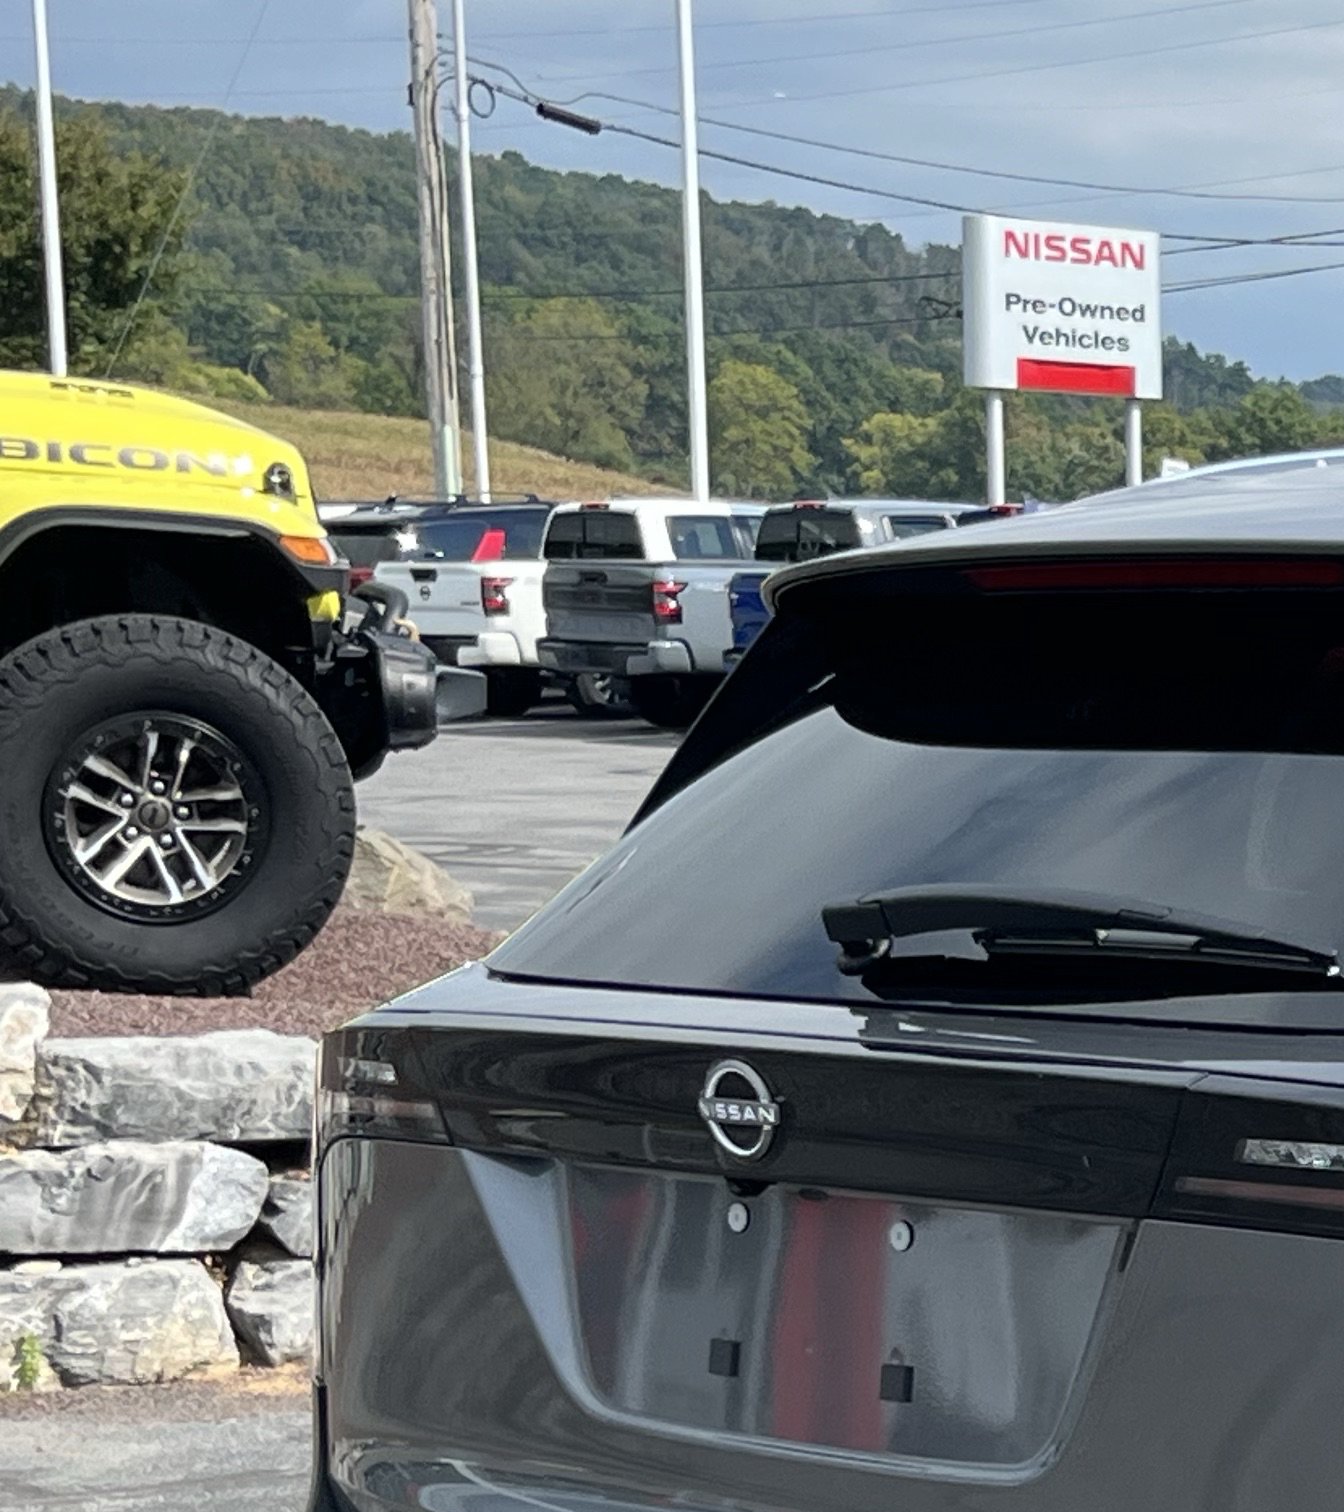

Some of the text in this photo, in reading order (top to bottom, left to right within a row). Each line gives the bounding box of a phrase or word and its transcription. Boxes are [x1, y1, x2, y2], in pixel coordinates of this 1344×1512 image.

[1004, 230, 1145, 270] NISSAN
[1005, 292, 1145, 323] Pre-Owned
[1022, 325, 1130, 352] Vehicles
[699, 1100, 776, 1123] NISSAN
